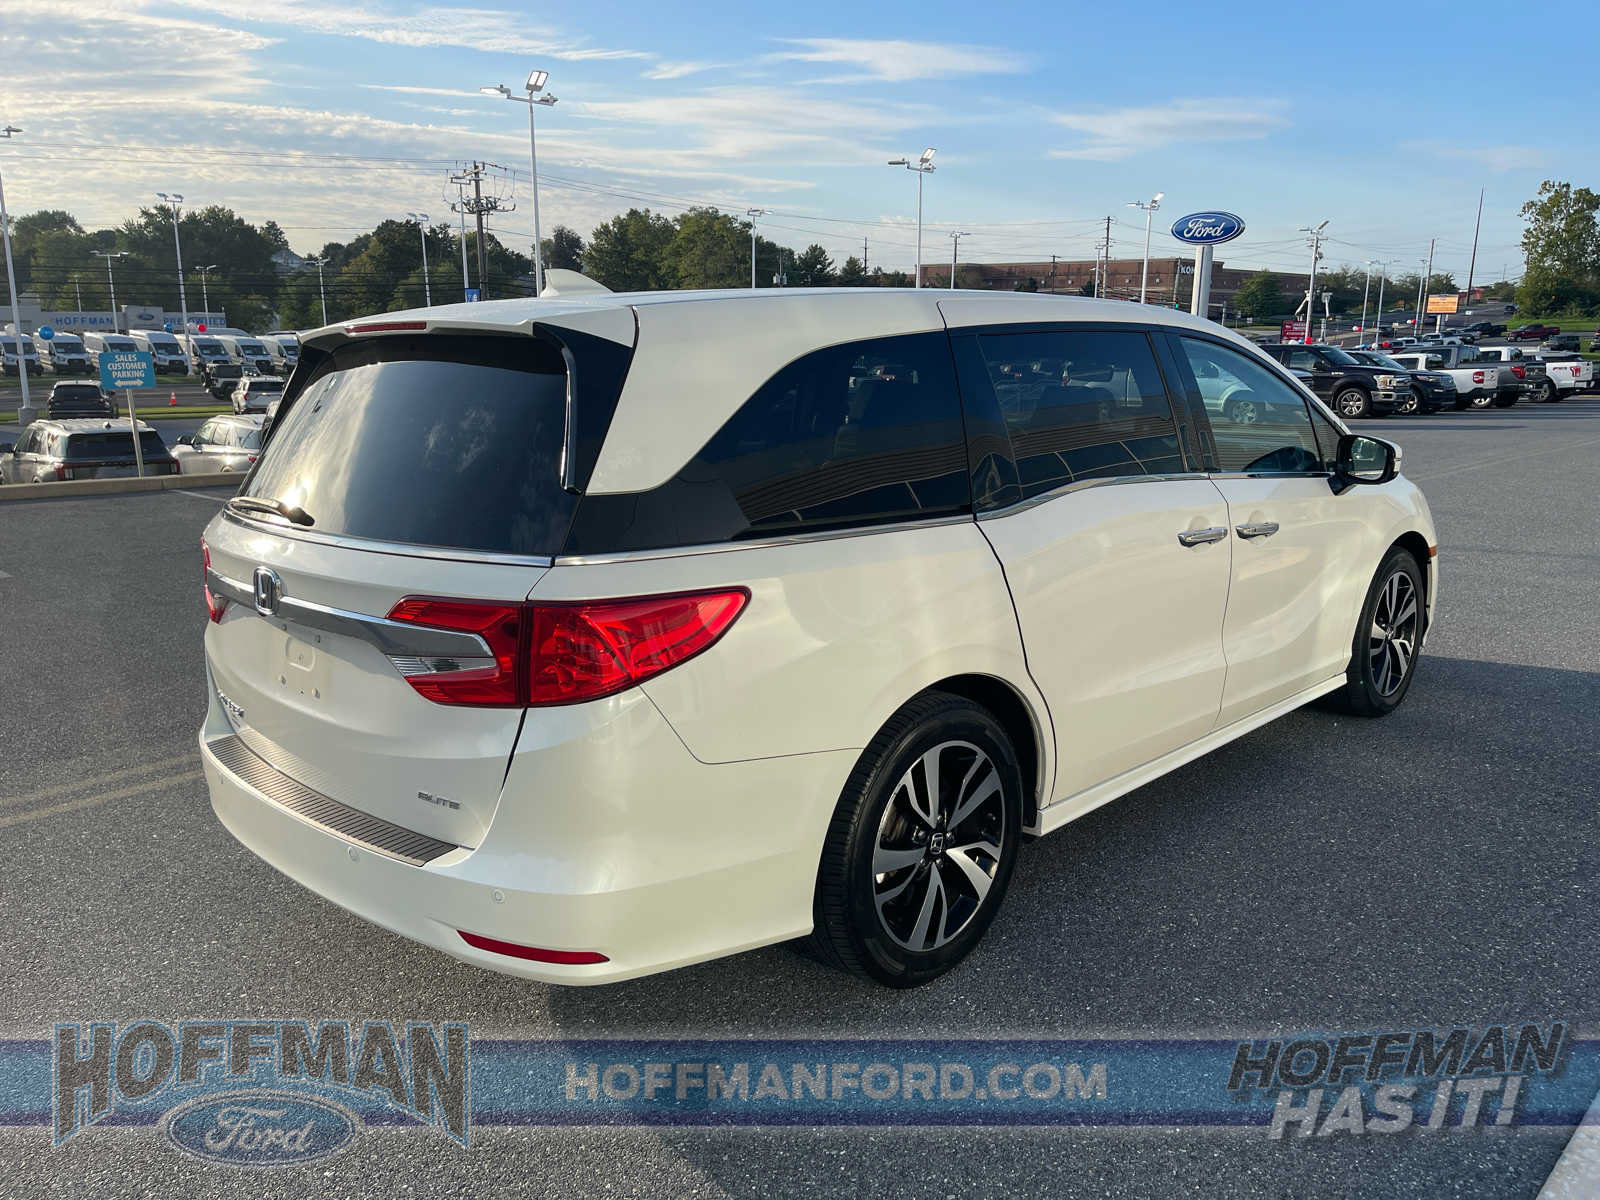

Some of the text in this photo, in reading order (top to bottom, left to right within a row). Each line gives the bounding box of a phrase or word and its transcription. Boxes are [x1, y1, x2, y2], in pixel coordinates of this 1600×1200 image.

[1183, 218, 1226, 238] Ford
[55, 317, 113, 326] HOFFMAN
[114, 353, 137, 362] SALES
[107, 362, 147, 371] CUSTOMER
[112, 370, 145, 379] PARKING
[417, 791, 461, 810] ELITE
